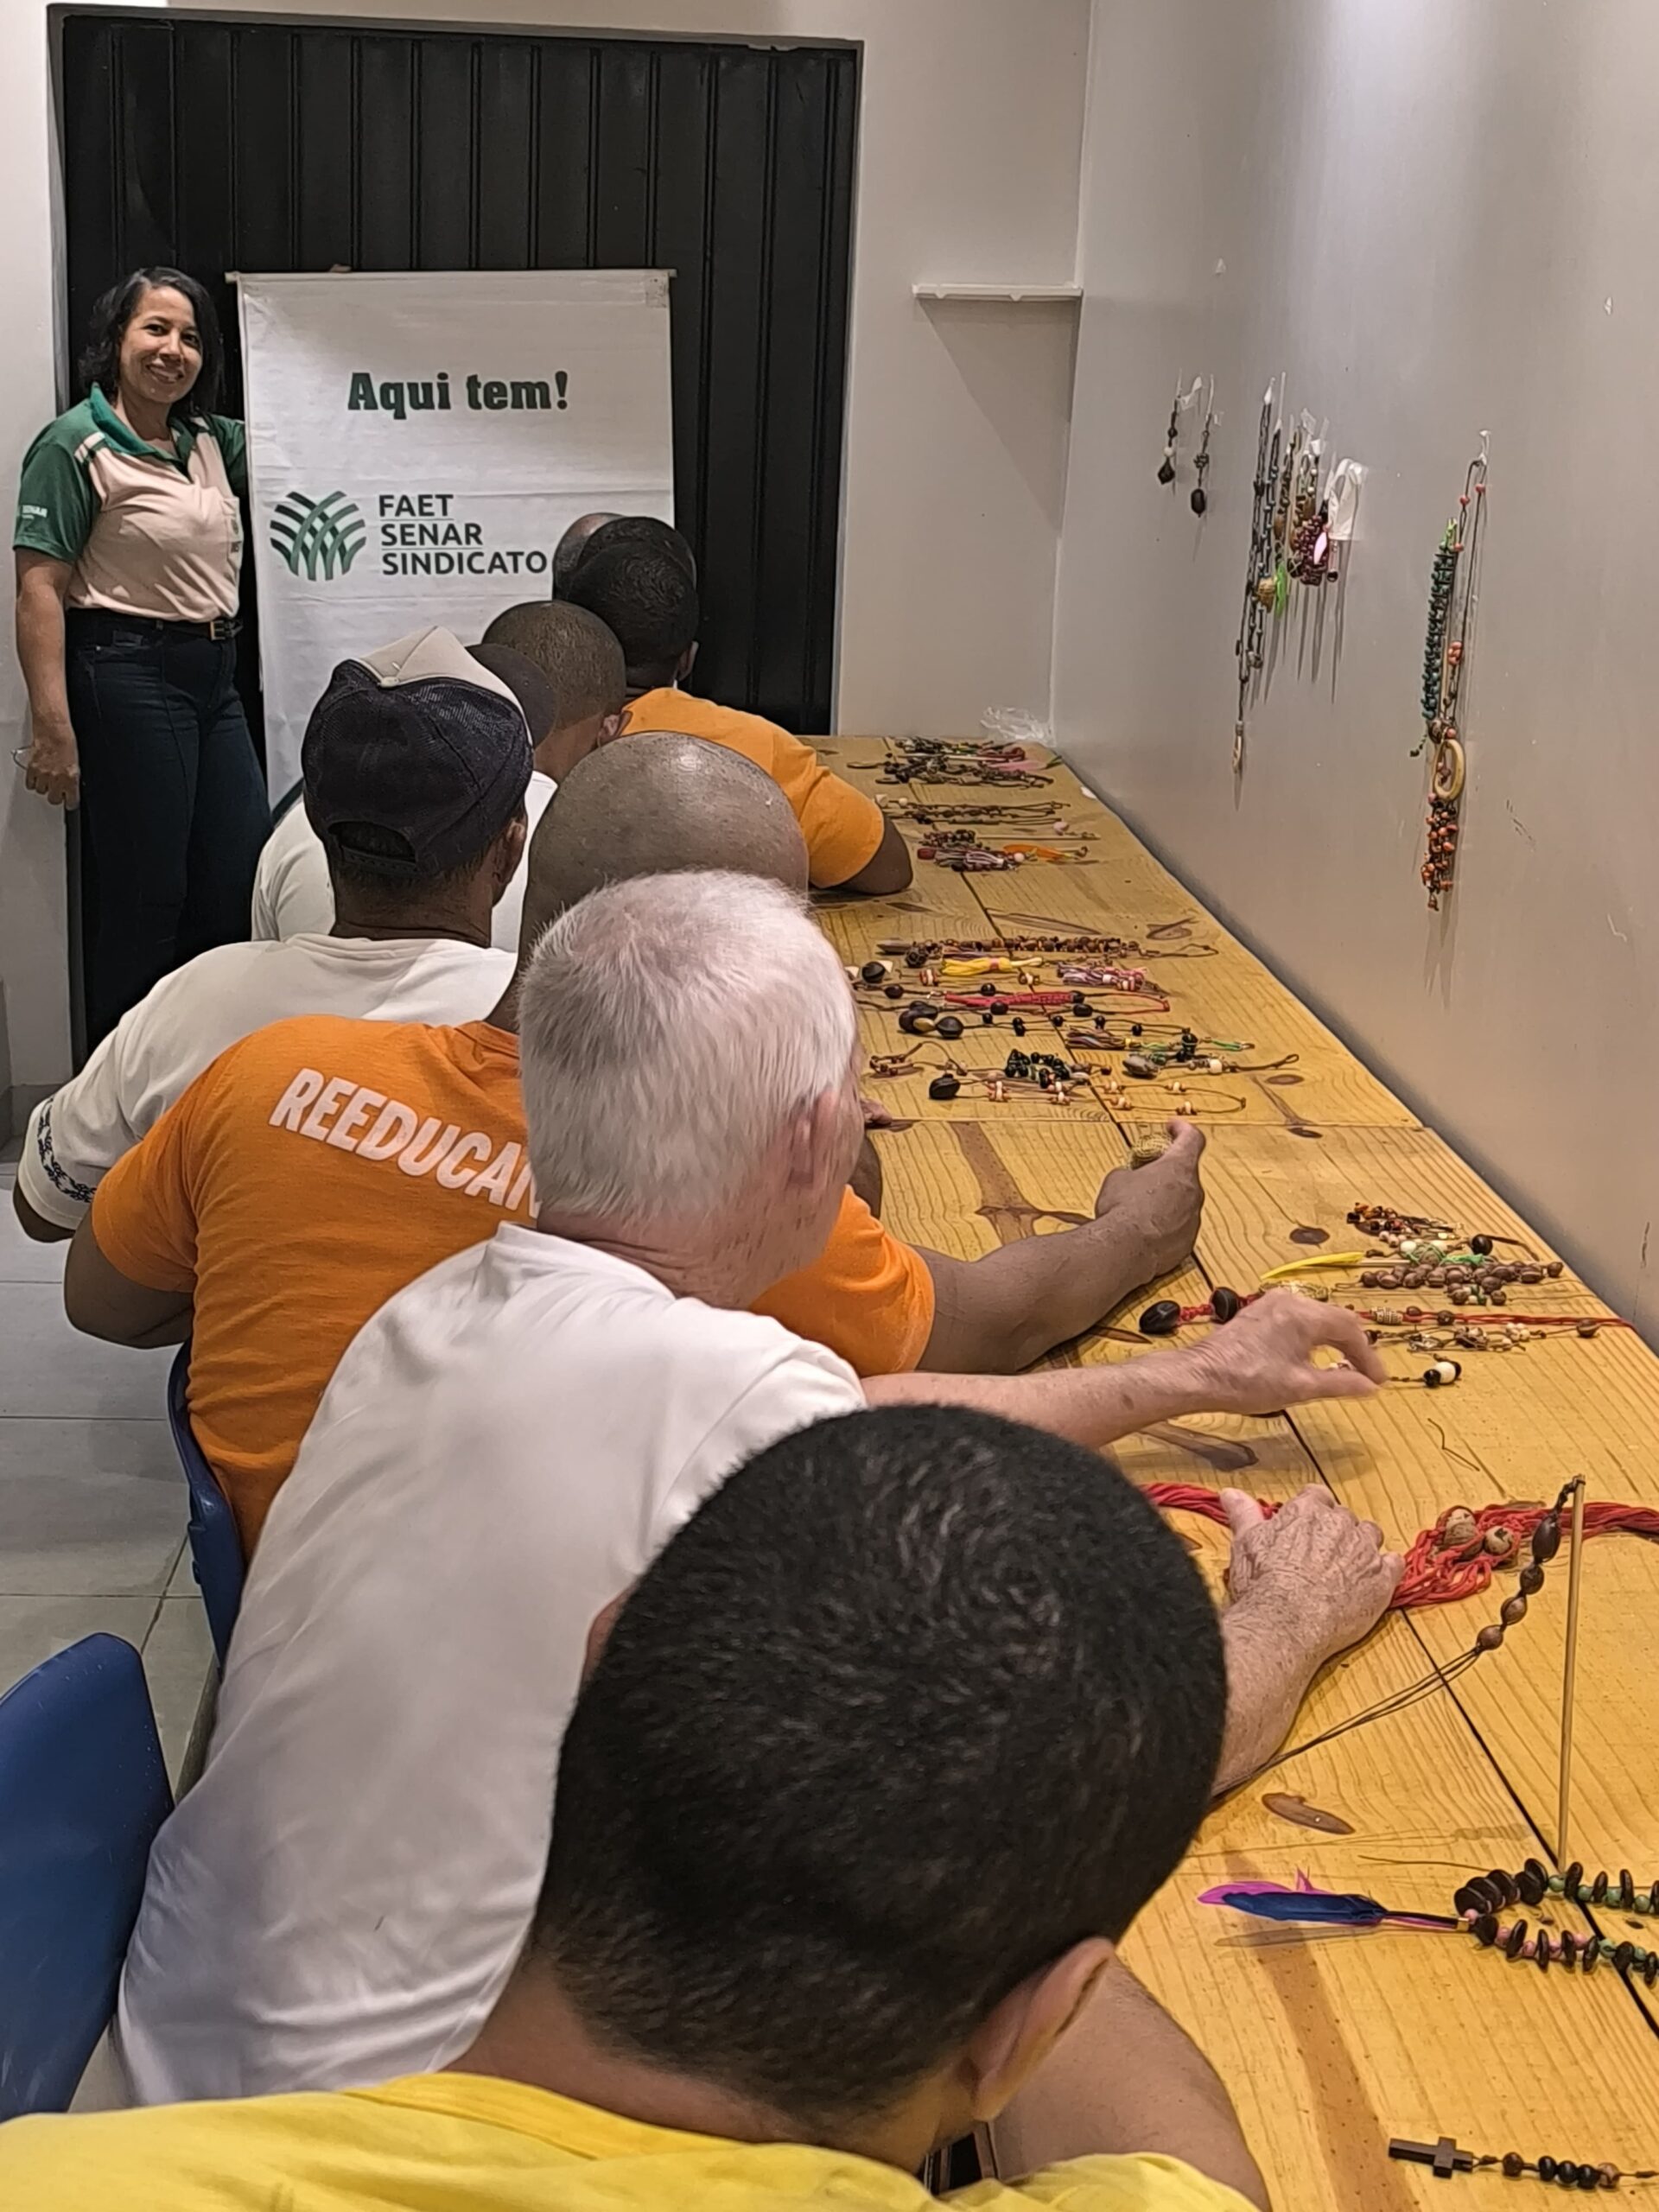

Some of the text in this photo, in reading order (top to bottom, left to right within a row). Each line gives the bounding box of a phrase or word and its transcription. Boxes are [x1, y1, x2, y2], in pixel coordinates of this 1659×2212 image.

[347, 370, 569, 420] Aqui tem!
[378, 494, 454, 517] FAET
[381, 523, 483, 546] SENAR
[382, 550, 548, 575] SINDICATO
